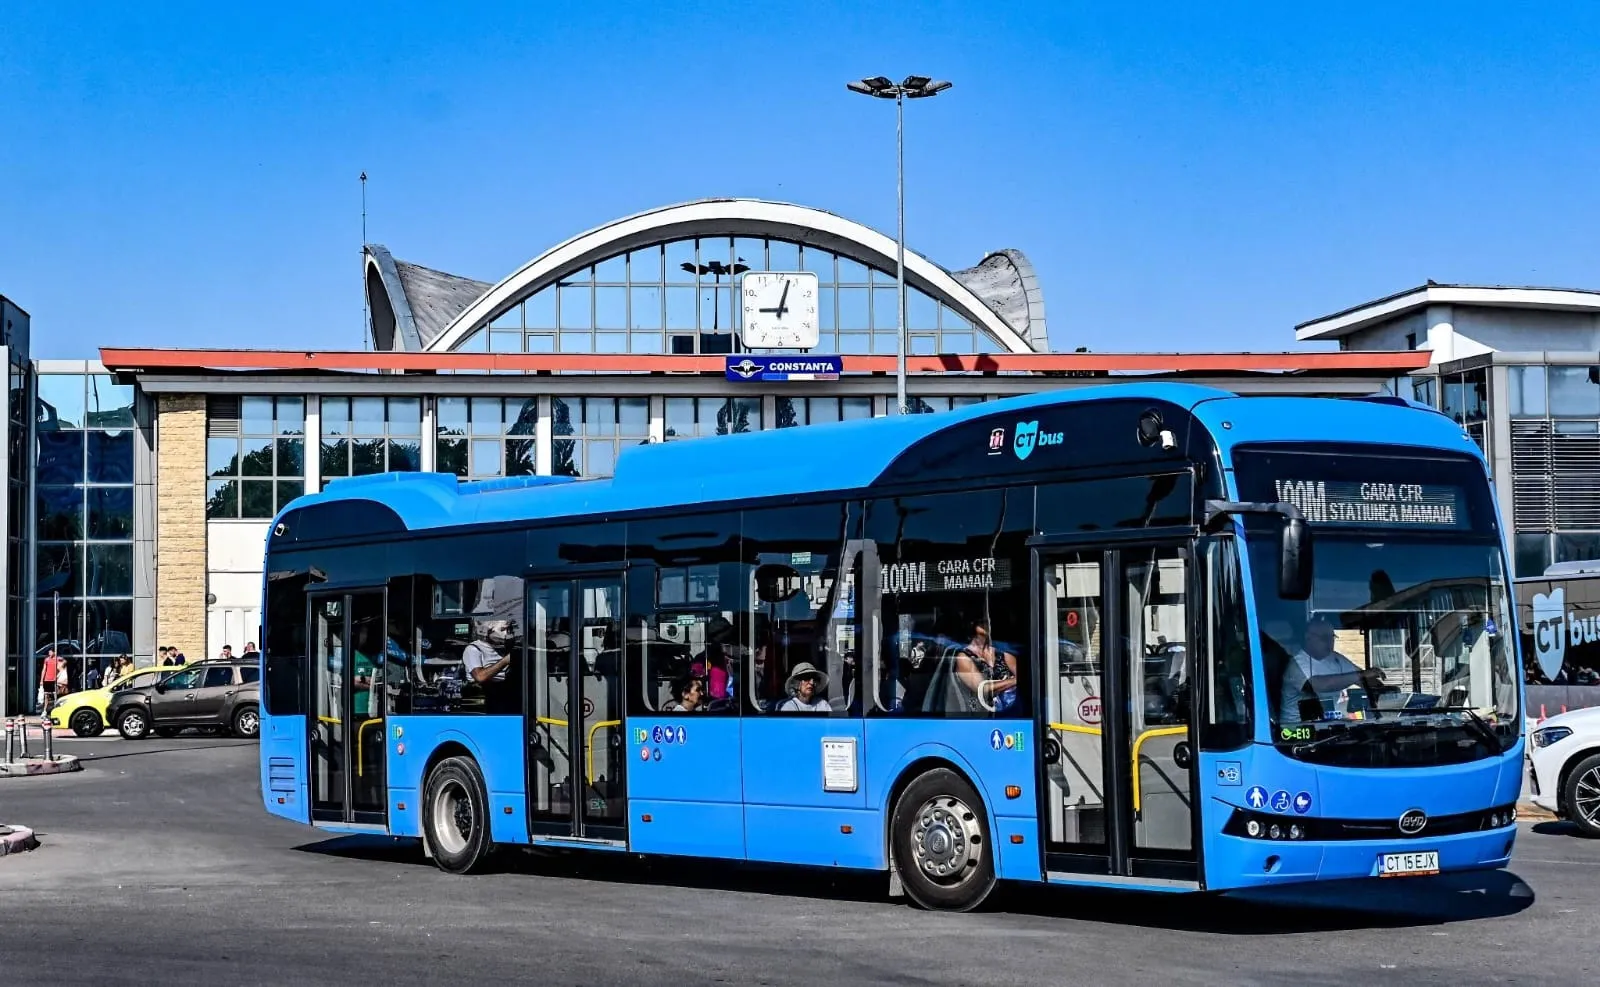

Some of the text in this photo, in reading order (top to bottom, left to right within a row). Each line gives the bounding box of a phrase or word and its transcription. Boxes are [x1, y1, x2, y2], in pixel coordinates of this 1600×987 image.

[1015, 431, 1064, 448] CT bus
[1360, 482, 1423, 502] GARA CFR
[1401, 504, 1454, 523] MAMAIA
[937, 557, 996, 574] GARA CFR
[880, 561, 926, 594] 100M
[943, 573, 994, 590] MAMAIA
[1537, 615, 1563, 654] CT
[1082, 704, 1102, 717] BY
[1296, 728, 1311, 740] E13
[1402, 816, 1424, 827] BYD
[1386, 853, 1435, 871] CT 15 EJX
